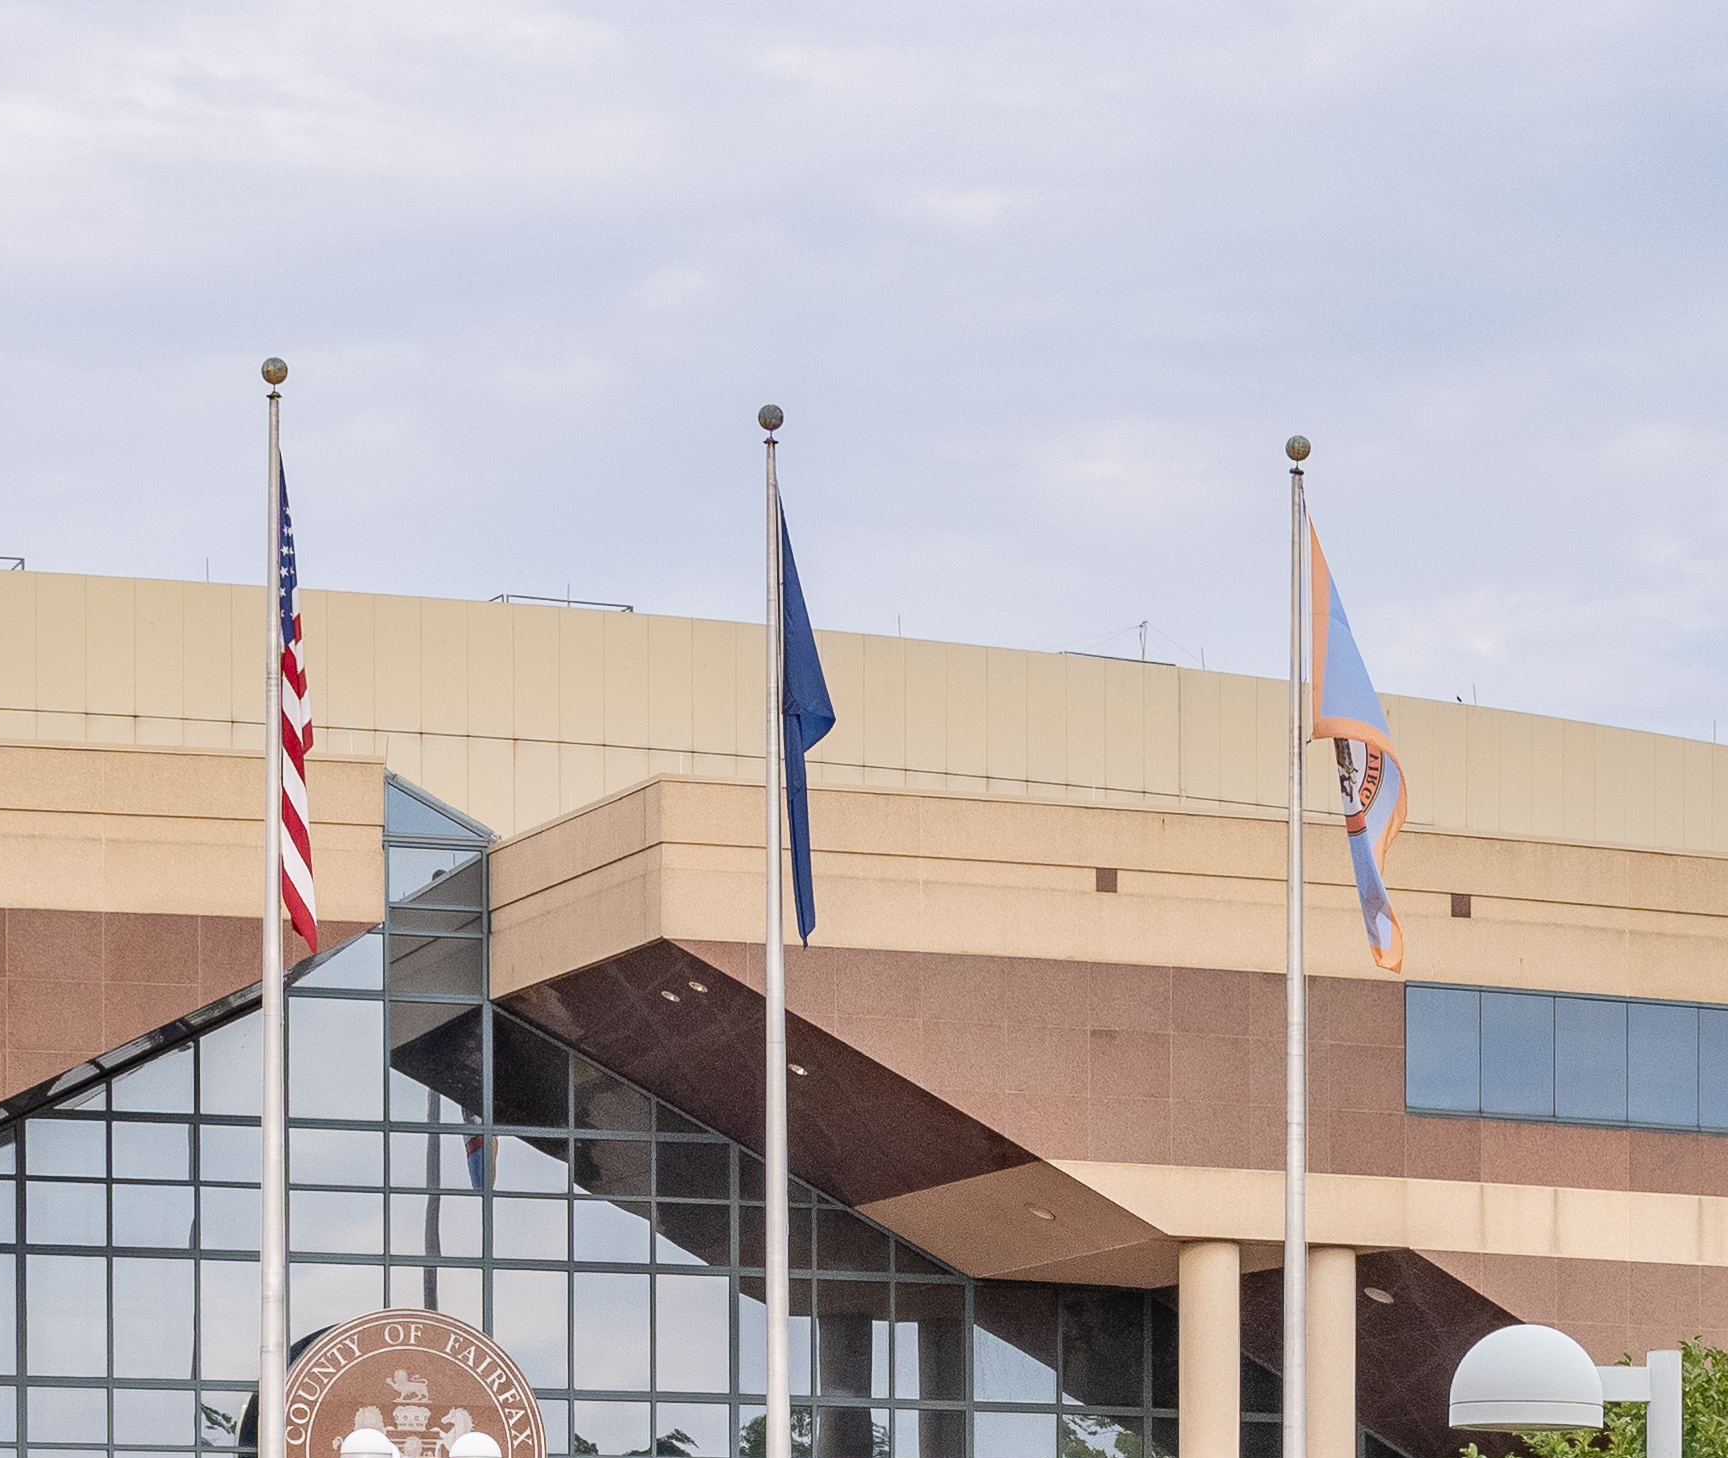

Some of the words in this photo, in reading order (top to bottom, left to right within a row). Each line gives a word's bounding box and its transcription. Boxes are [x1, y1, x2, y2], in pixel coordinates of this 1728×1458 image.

[285, 1334, 362, 1445] COUNTY
[384, 1324, 424, 1345] OF
[445, 1333, 533, 1449] FAIRFAX
